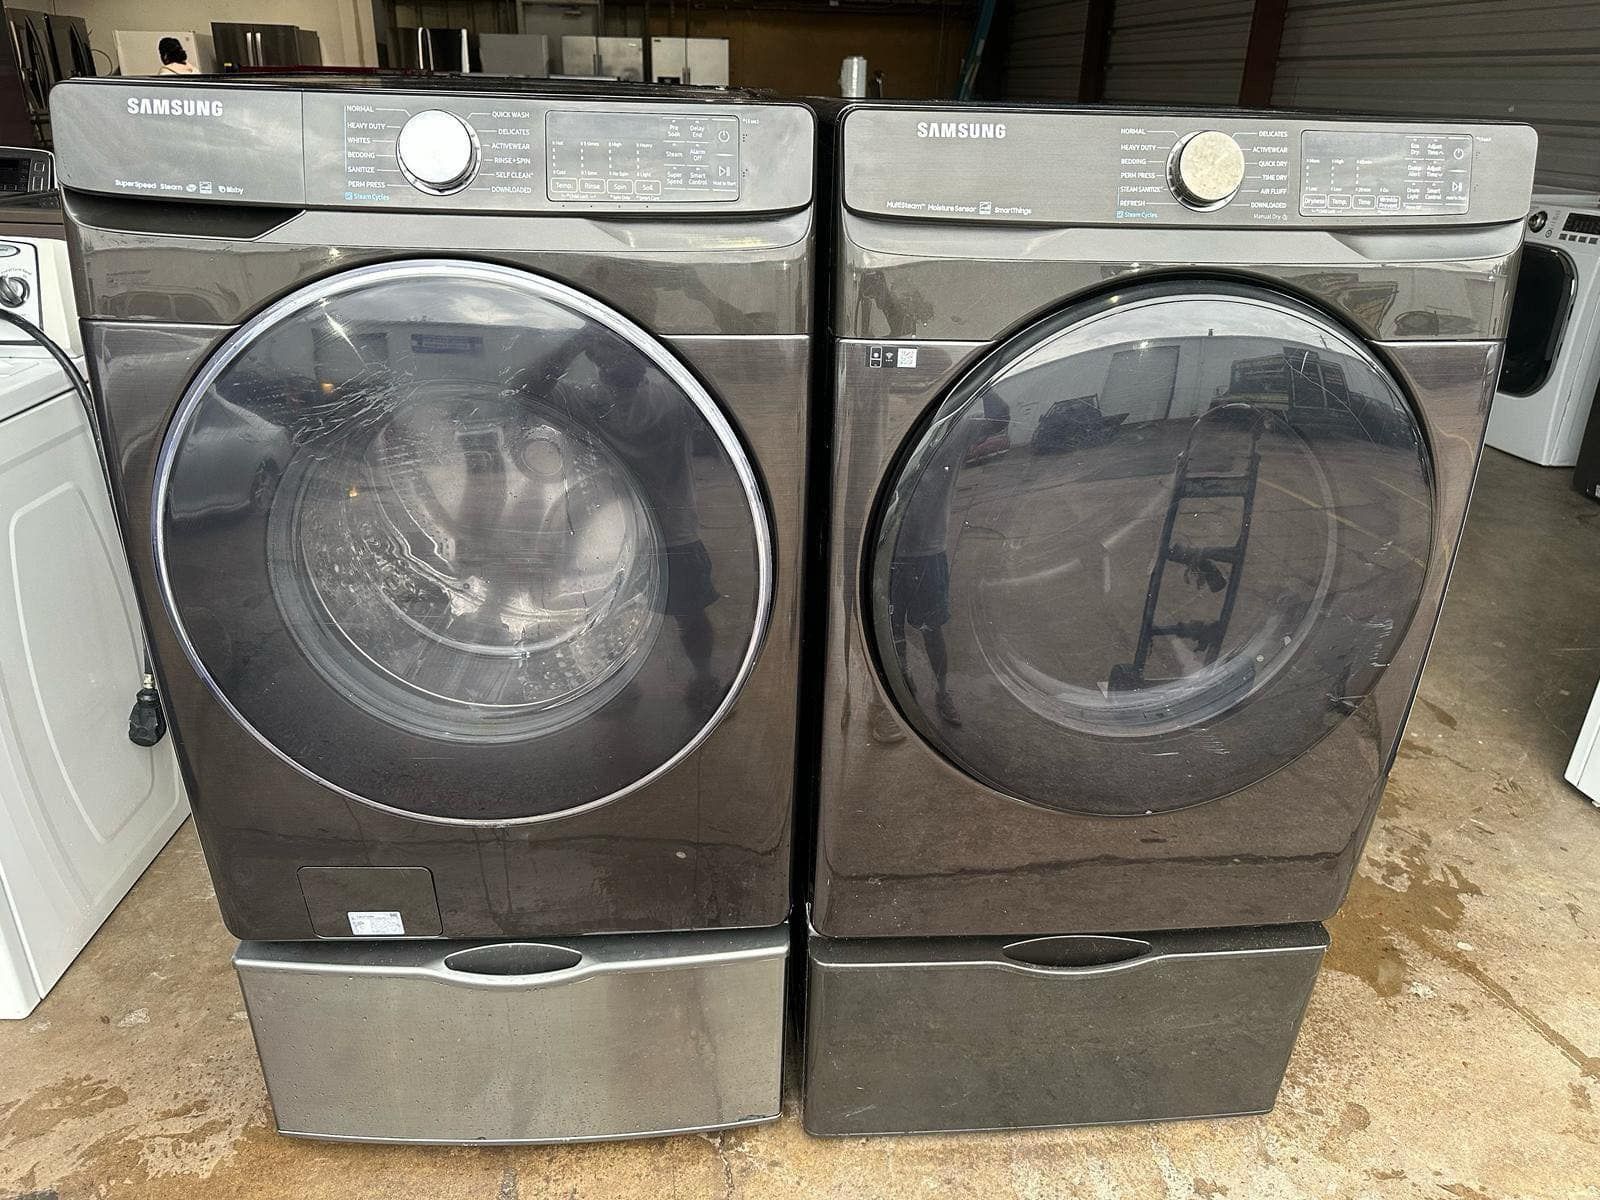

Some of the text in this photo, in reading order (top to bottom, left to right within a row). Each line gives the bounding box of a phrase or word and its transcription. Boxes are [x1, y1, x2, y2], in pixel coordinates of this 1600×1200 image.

[127, 98, 223, 117] SAMSUNG
[917, 122, 1007, 139] SAMSUNG
[114, 179, 156, 190] SuperSpeed
[491, 186, 532, 194] DOWNLOADED
